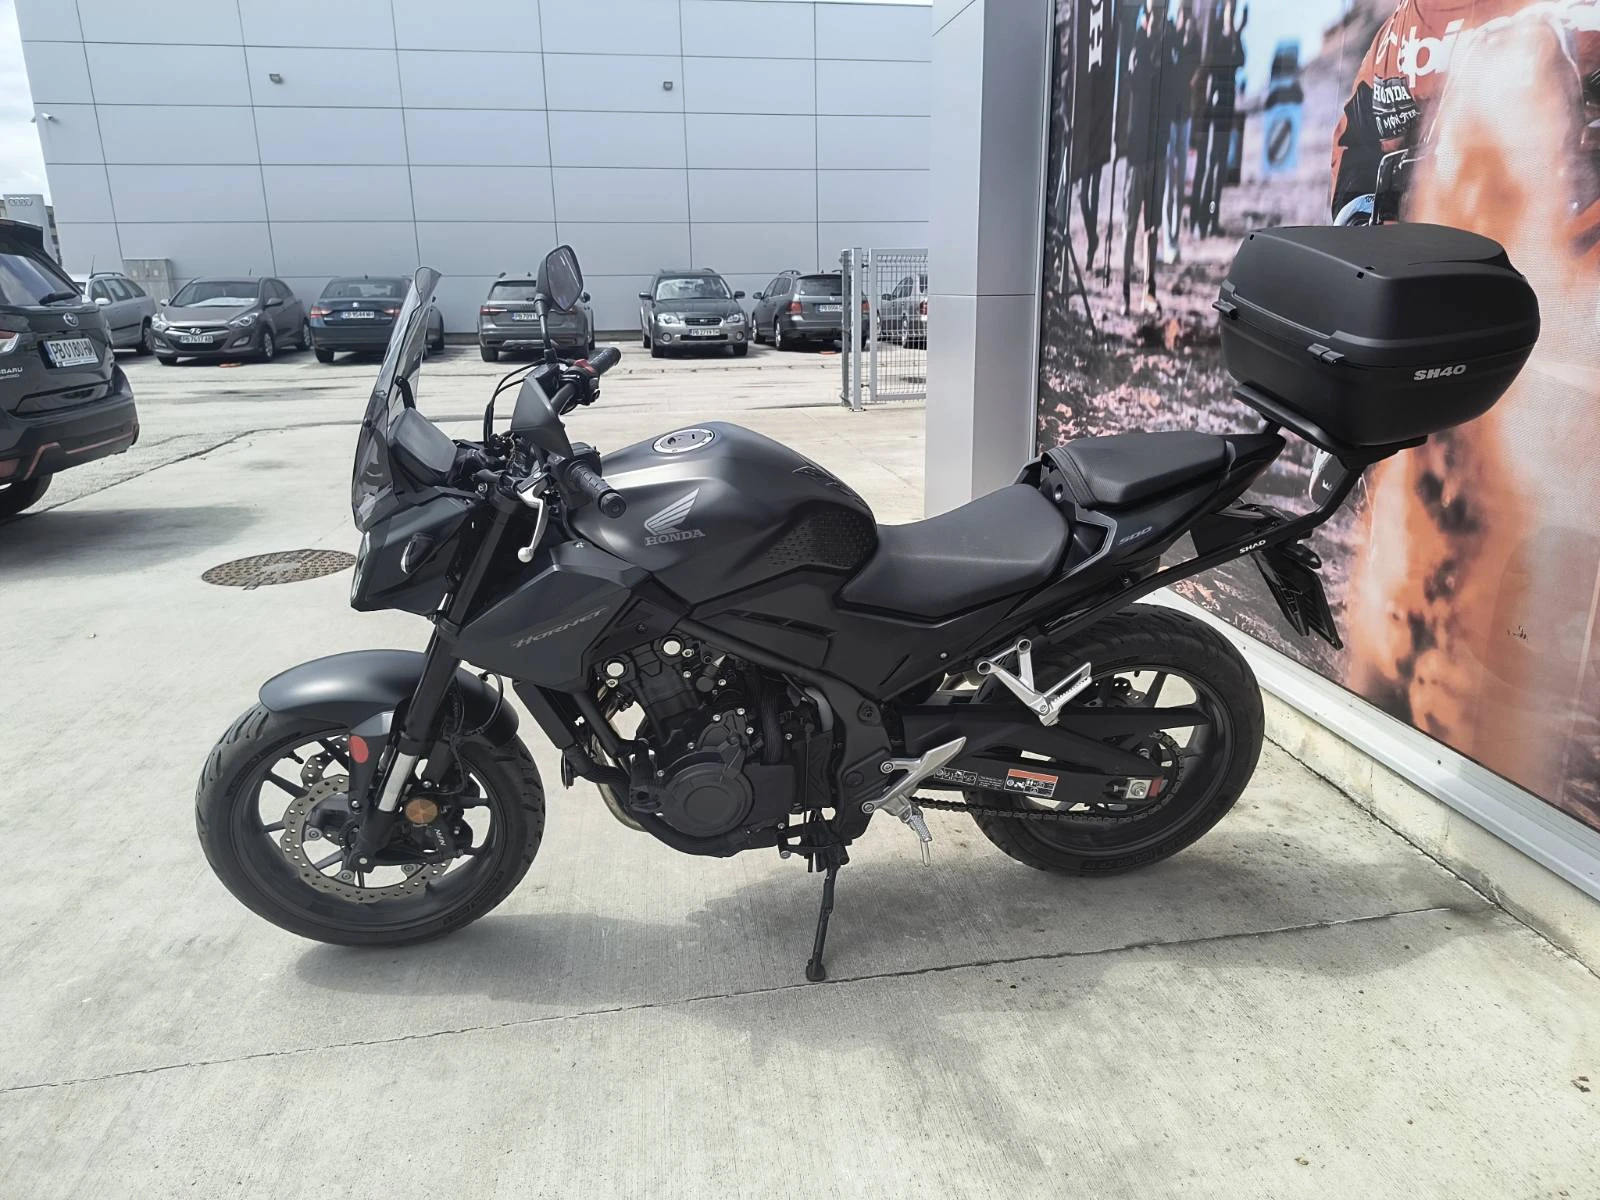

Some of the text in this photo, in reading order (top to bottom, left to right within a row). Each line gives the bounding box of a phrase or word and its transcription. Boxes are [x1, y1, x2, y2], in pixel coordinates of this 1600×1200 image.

[1373, 83, 1411, 103] HONDA
[1413, 364, 1467, 381] SH40
[645, 529, 706, 546] HONDA
[1239, 539, 1267, 554] SHAD
[512, 607, 607, 649] HORNET
